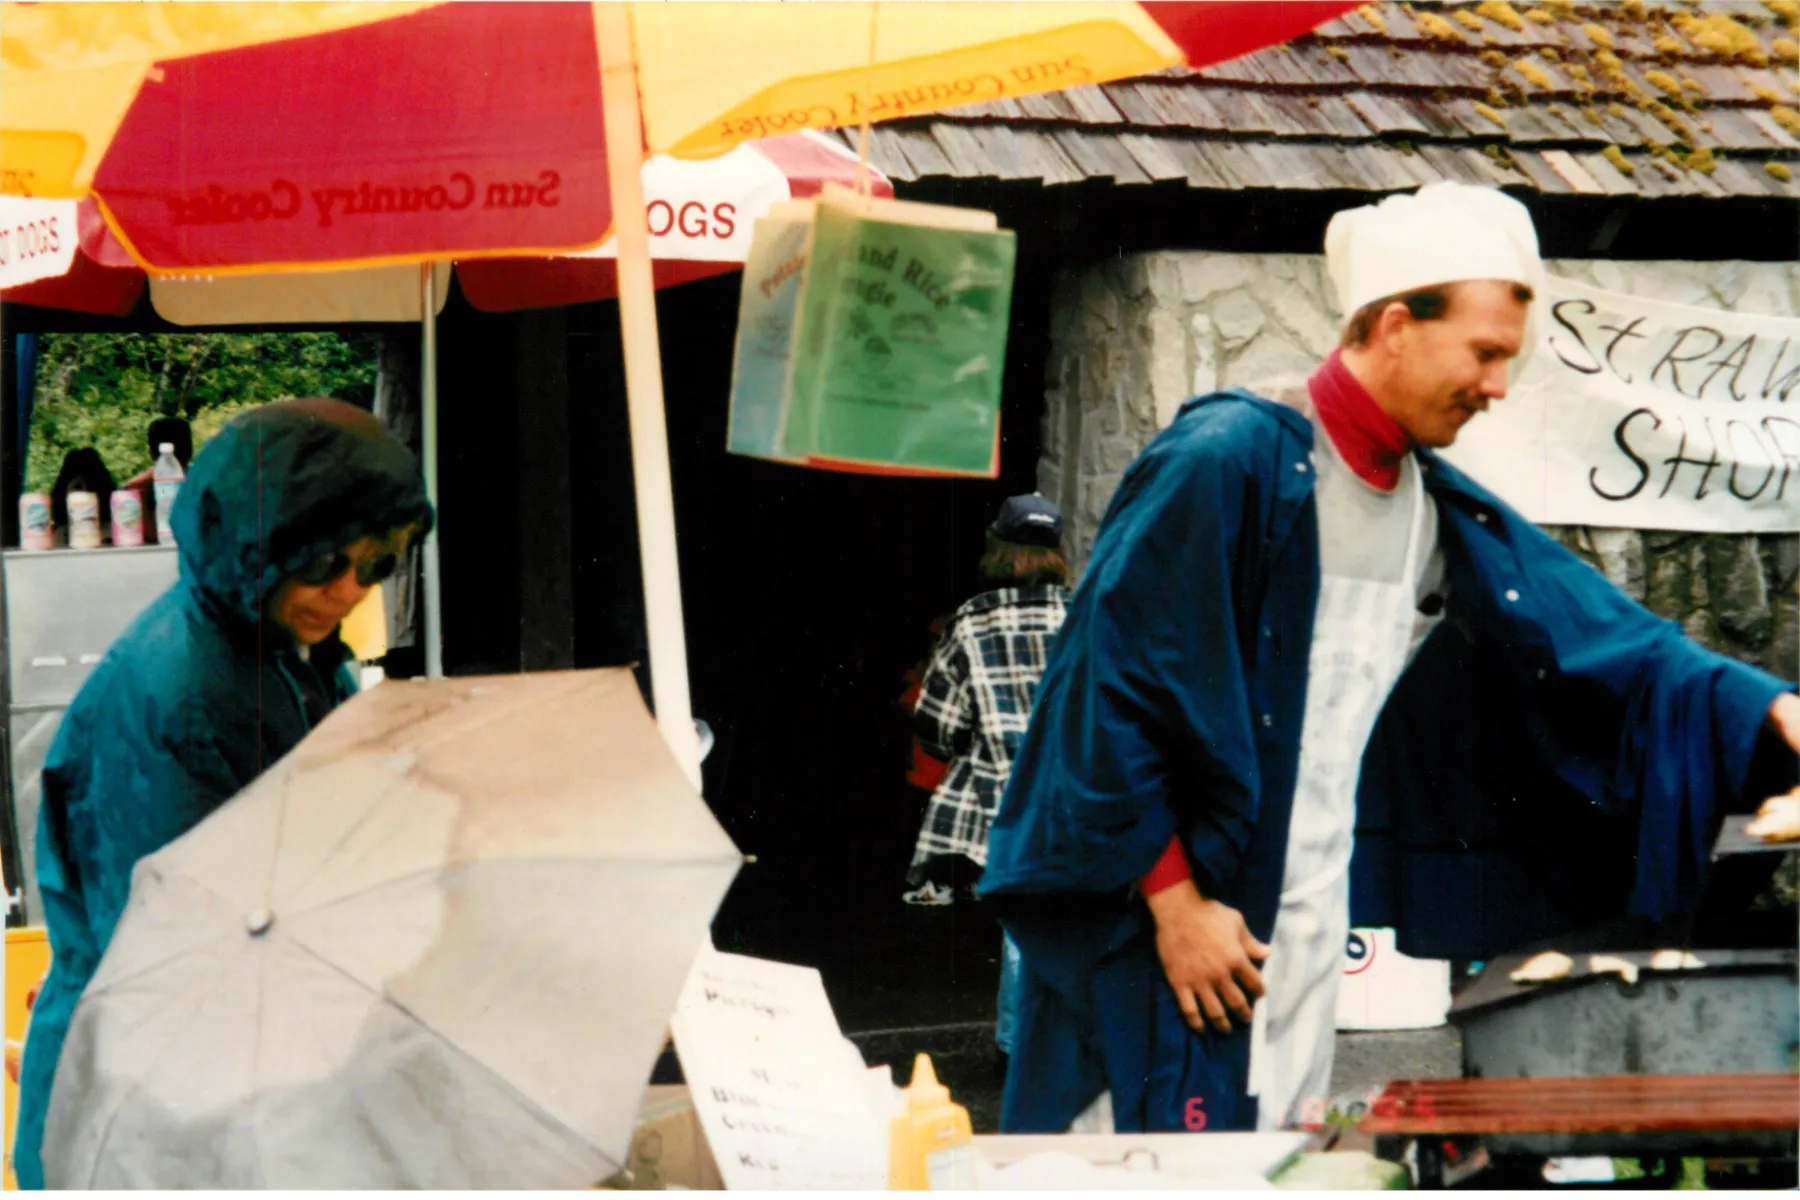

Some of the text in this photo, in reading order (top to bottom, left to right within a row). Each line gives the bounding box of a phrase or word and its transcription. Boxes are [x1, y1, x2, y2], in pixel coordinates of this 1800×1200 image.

[720, 53, 1093, 138] Sun Country Cooler
[645, 199, 736, 240] OGS
[902, 256, 951, 311] Rice
